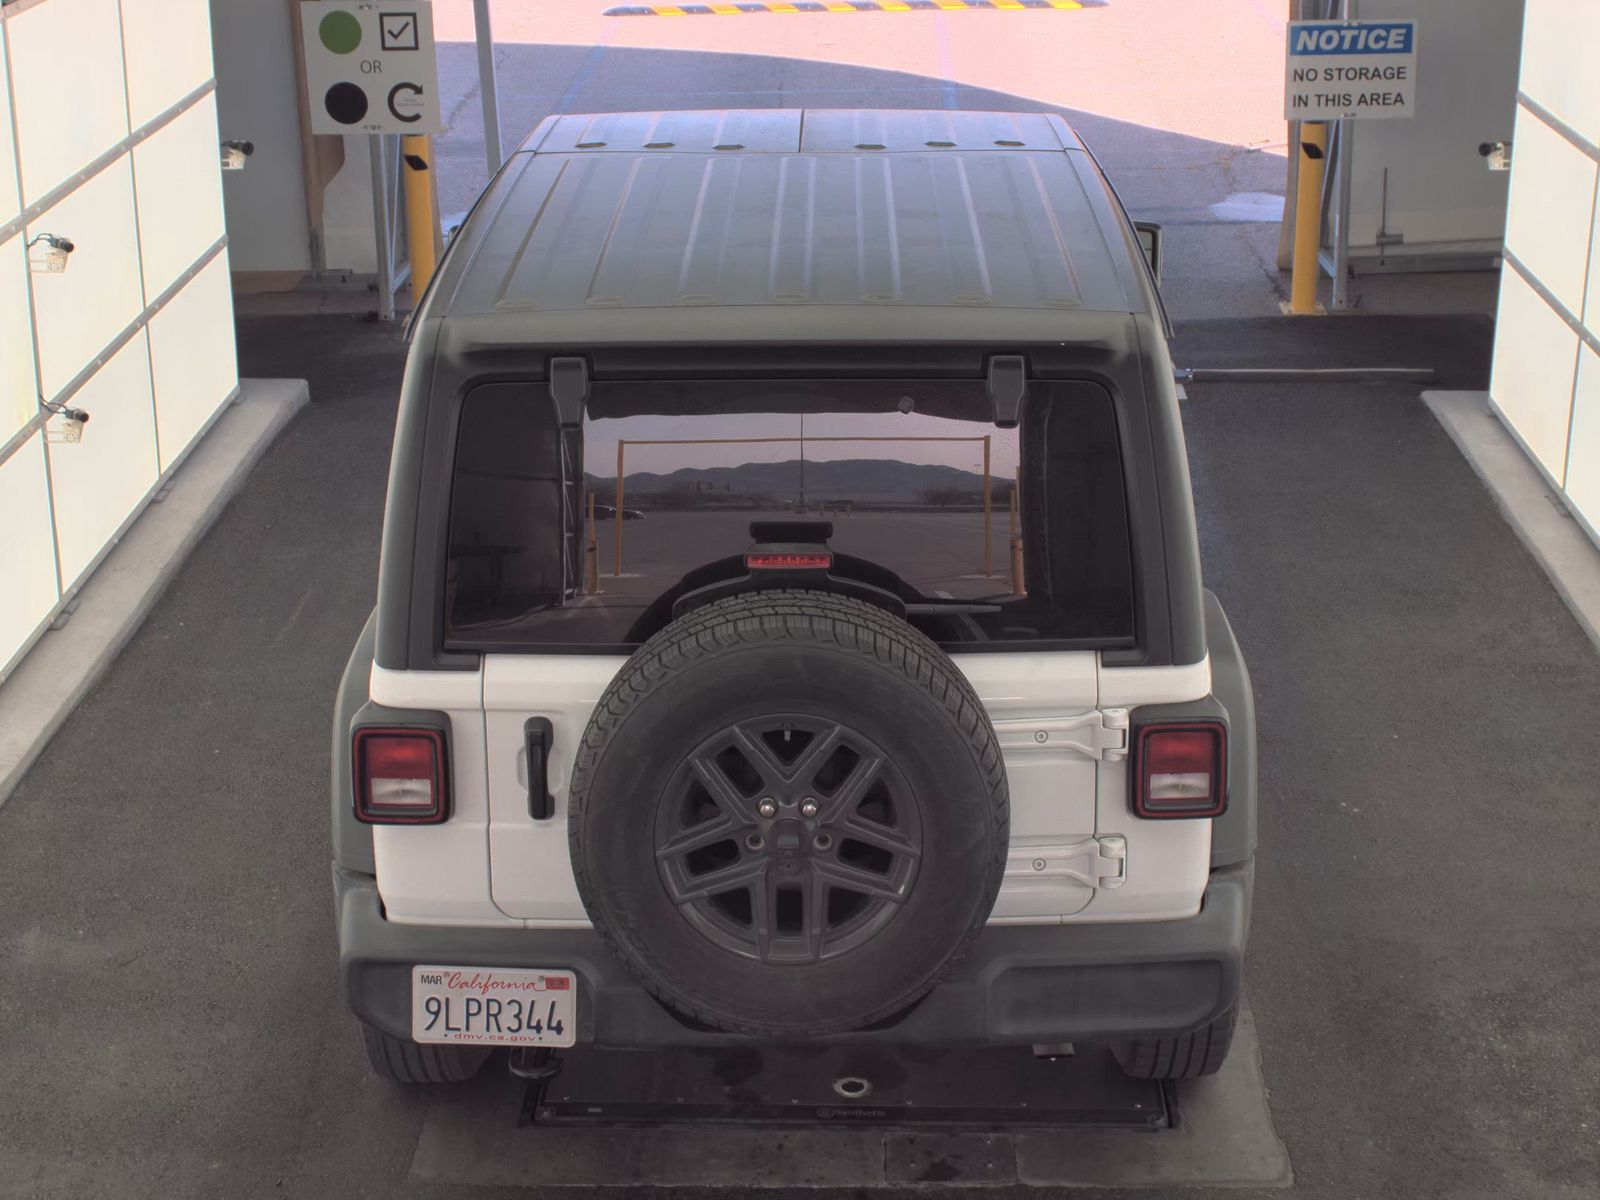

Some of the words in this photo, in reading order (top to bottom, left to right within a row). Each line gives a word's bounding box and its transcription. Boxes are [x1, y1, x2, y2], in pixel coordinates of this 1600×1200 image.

[1296, 28, 1407, 51] NOTICE
[360, 60, 382, 74] OR
[1293, 68, 1318, 82] NO
[1323, 66, 1407, 81] STORAGE
[1293, 94, 1309, 108] IN
[1314, 93, 1352, 107] THIS
[1357, 92, 1405, 106] AREA
[421, 974, 443, 985] MAR
[448, 971, 547, 995] California
[424, 996, 564, 1036] 9LPR344
[454, 1032, 536, 1042] dmv.ca.gov
